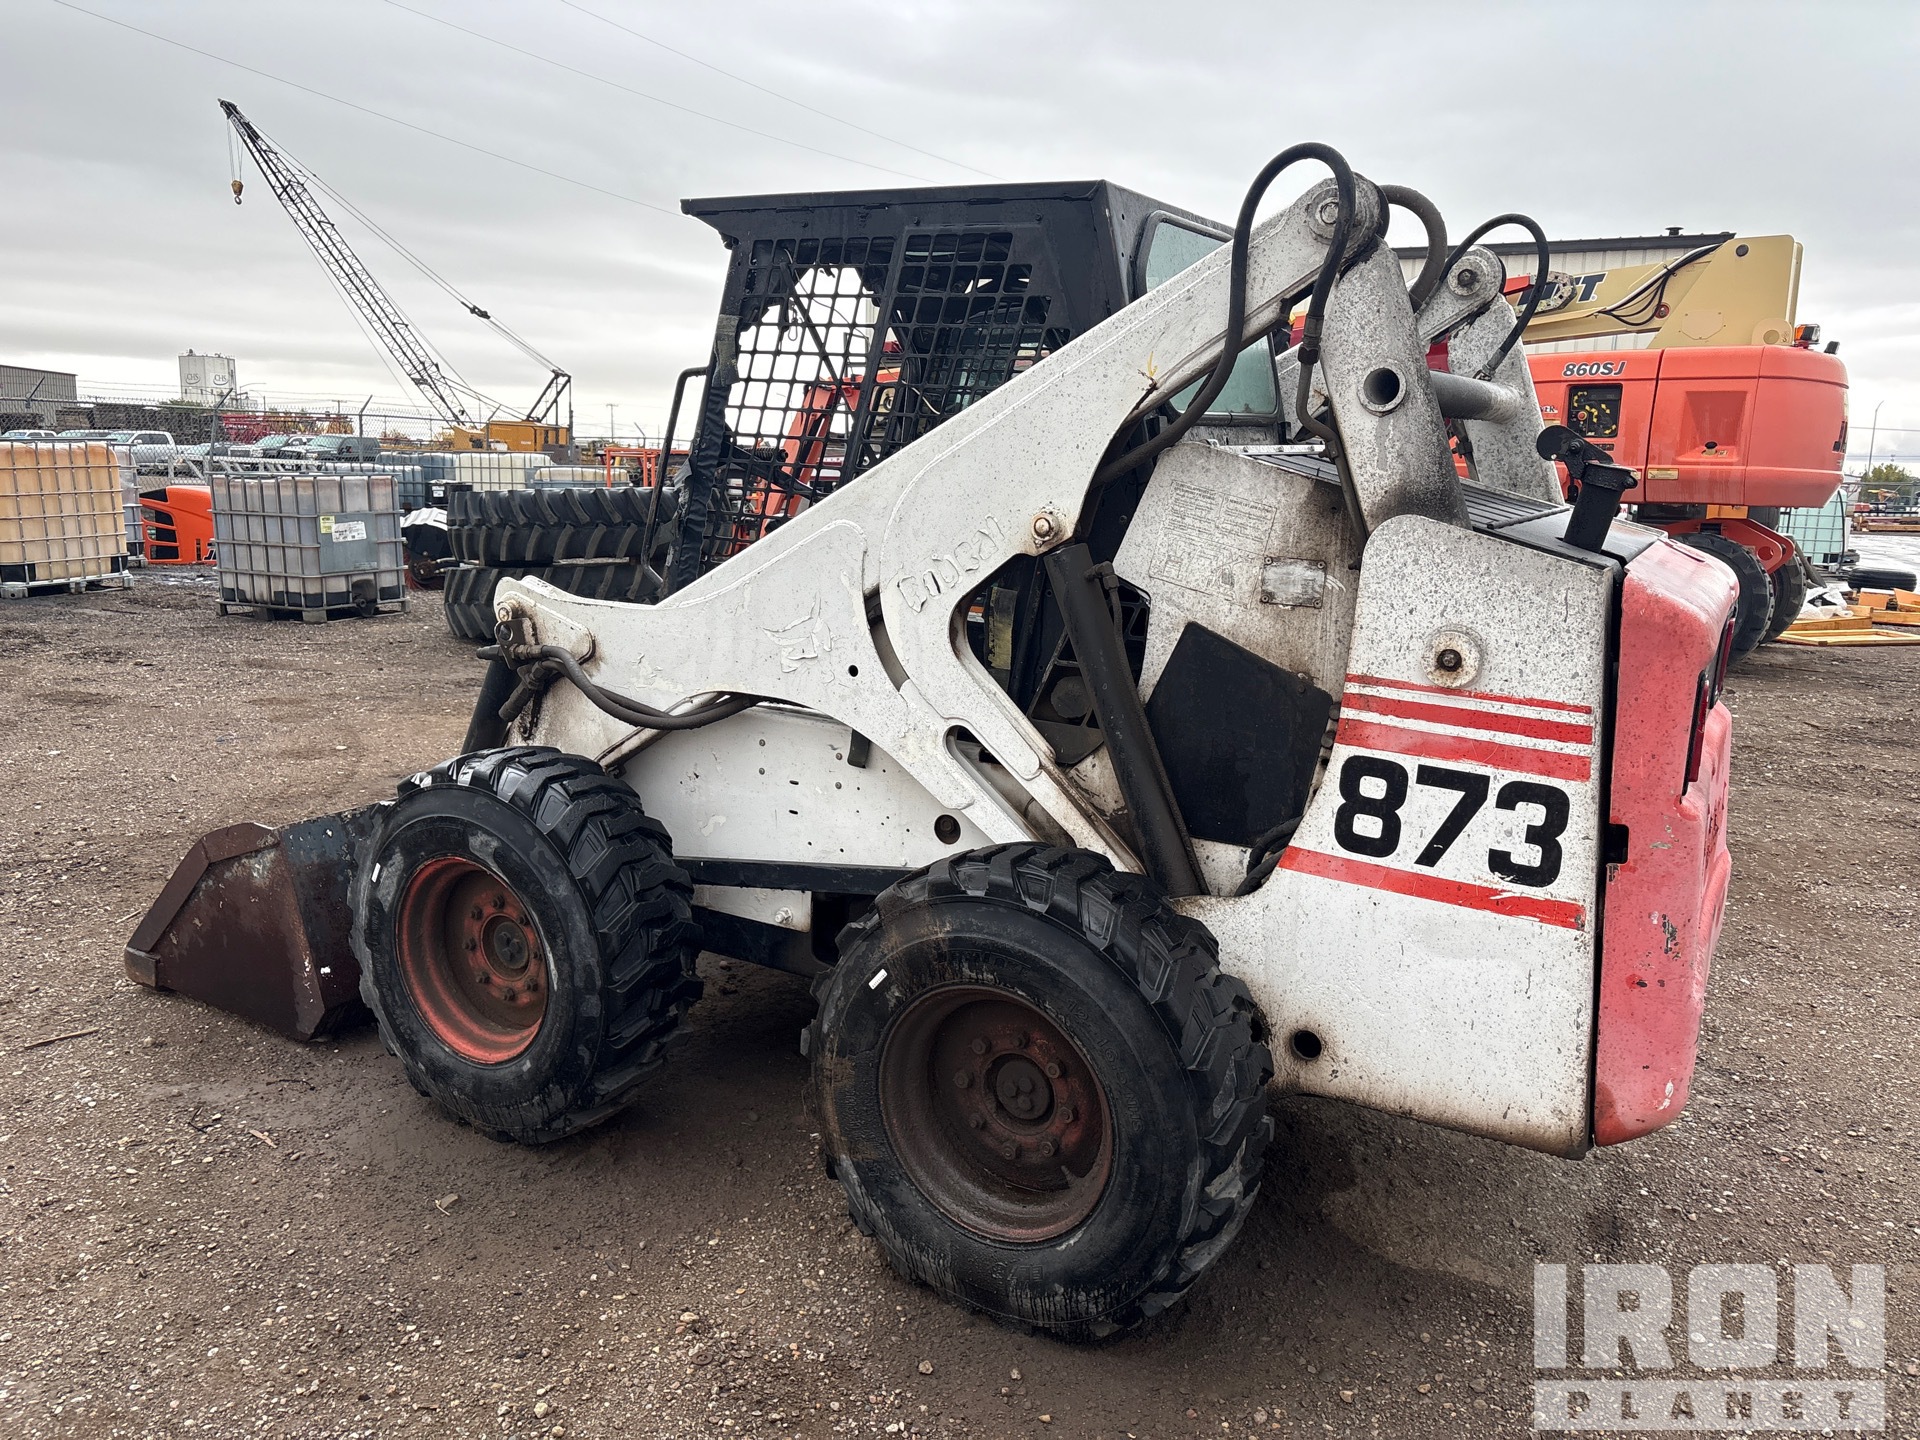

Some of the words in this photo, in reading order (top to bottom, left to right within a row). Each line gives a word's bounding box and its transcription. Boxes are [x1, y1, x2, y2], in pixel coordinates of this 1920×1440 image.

[1562, 361, 1627, 378] 860SJ
[186, 373, 199, 381] CHS
[214, 374, 227, 382] CHS
[1334, 755, 1570, 888] 873
